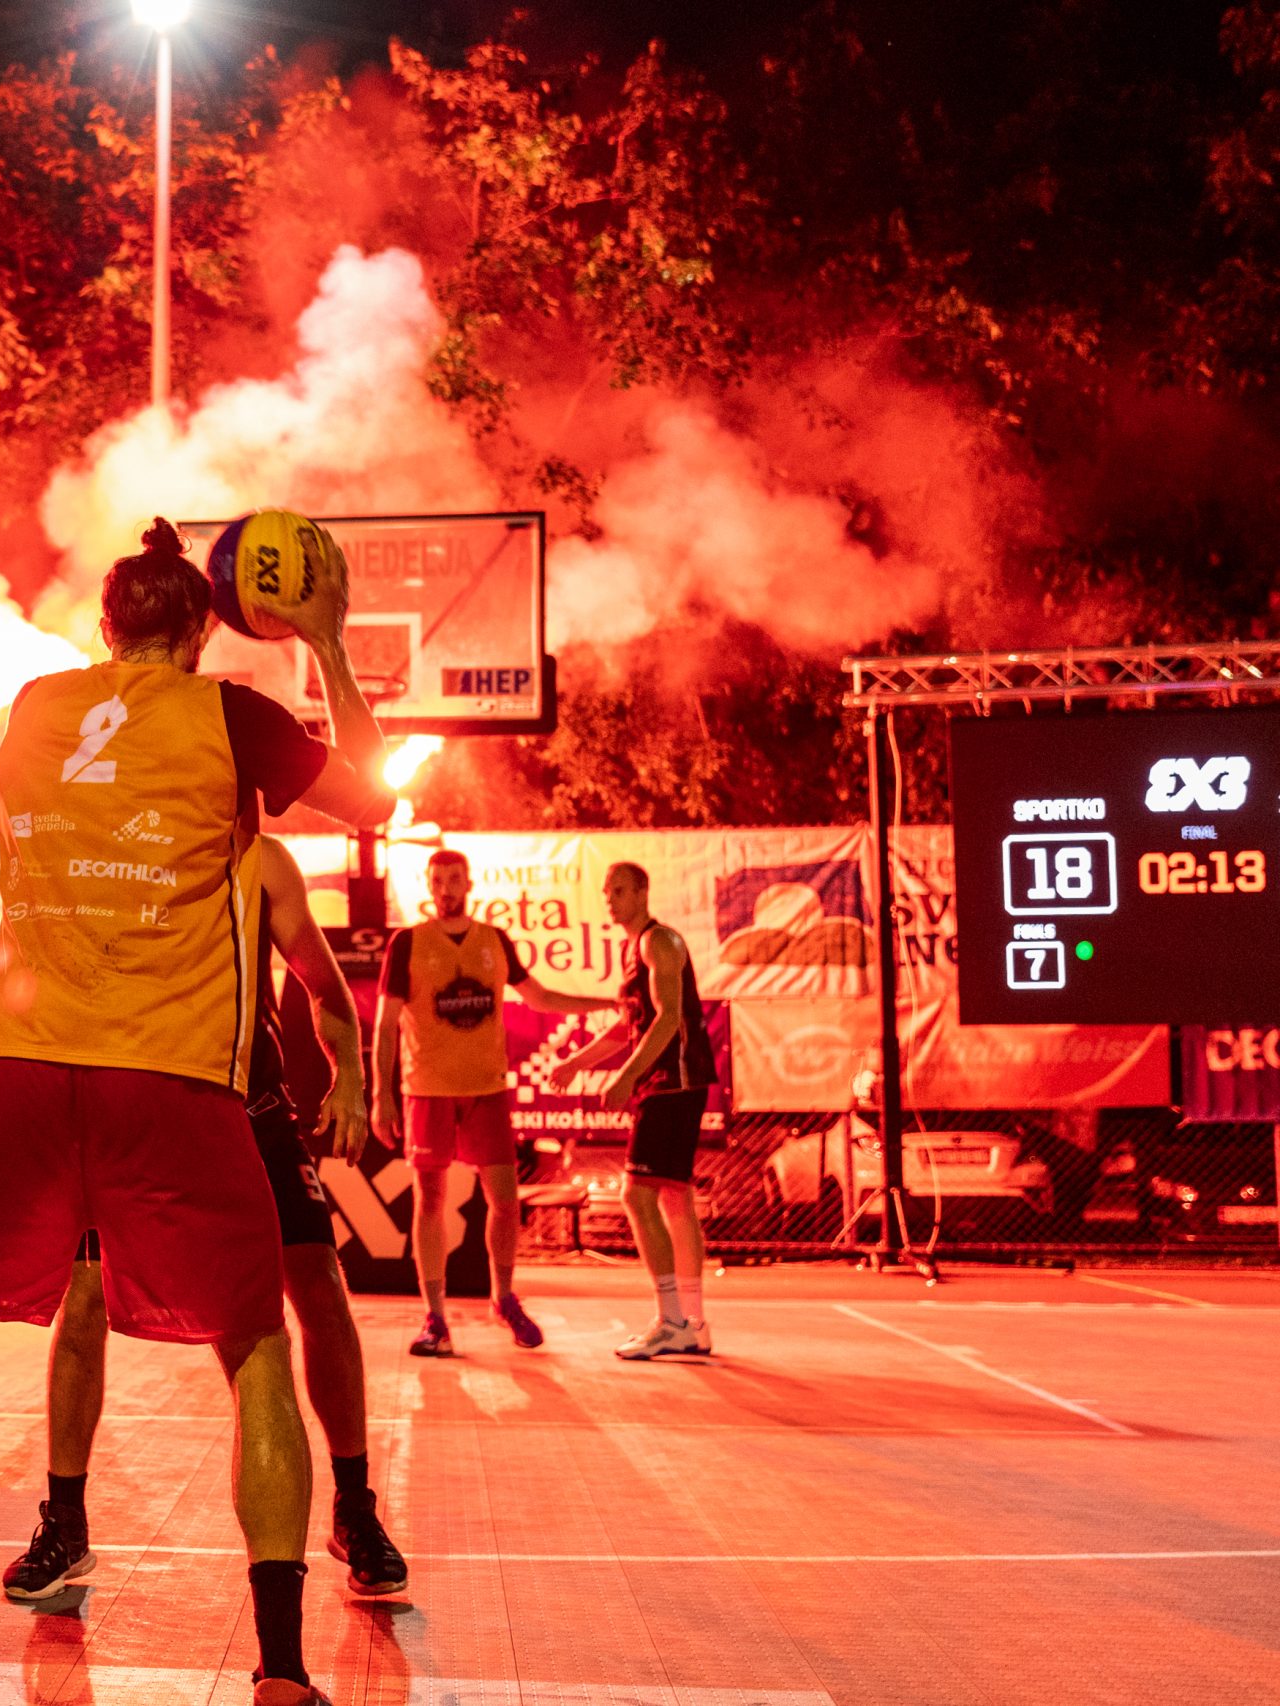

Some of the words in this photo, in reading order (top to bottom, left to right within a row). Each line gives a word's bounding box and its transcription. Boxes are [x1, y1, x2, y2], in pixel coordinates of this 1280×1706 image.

[475, 669, 531, 695] HEP
[61, 693, 128, 783] 2
[1144, 756, 1251, 812] 3X3
[1013, 798, 1106, 822] SPORTKO
[136, 831, 175, 845] HKS
[1181, 825, 1218, 840] FINAL
[68, 858, 177, 888] DECATHLON
[1025, 846, 1093, 900] 18
[1138, 850, 1267, 895] 02:13
[75, 904, 116, 918] Weiss
[1013, 924, 1056, 940] FOULS
[1024, 949, 1047, 981] 7
